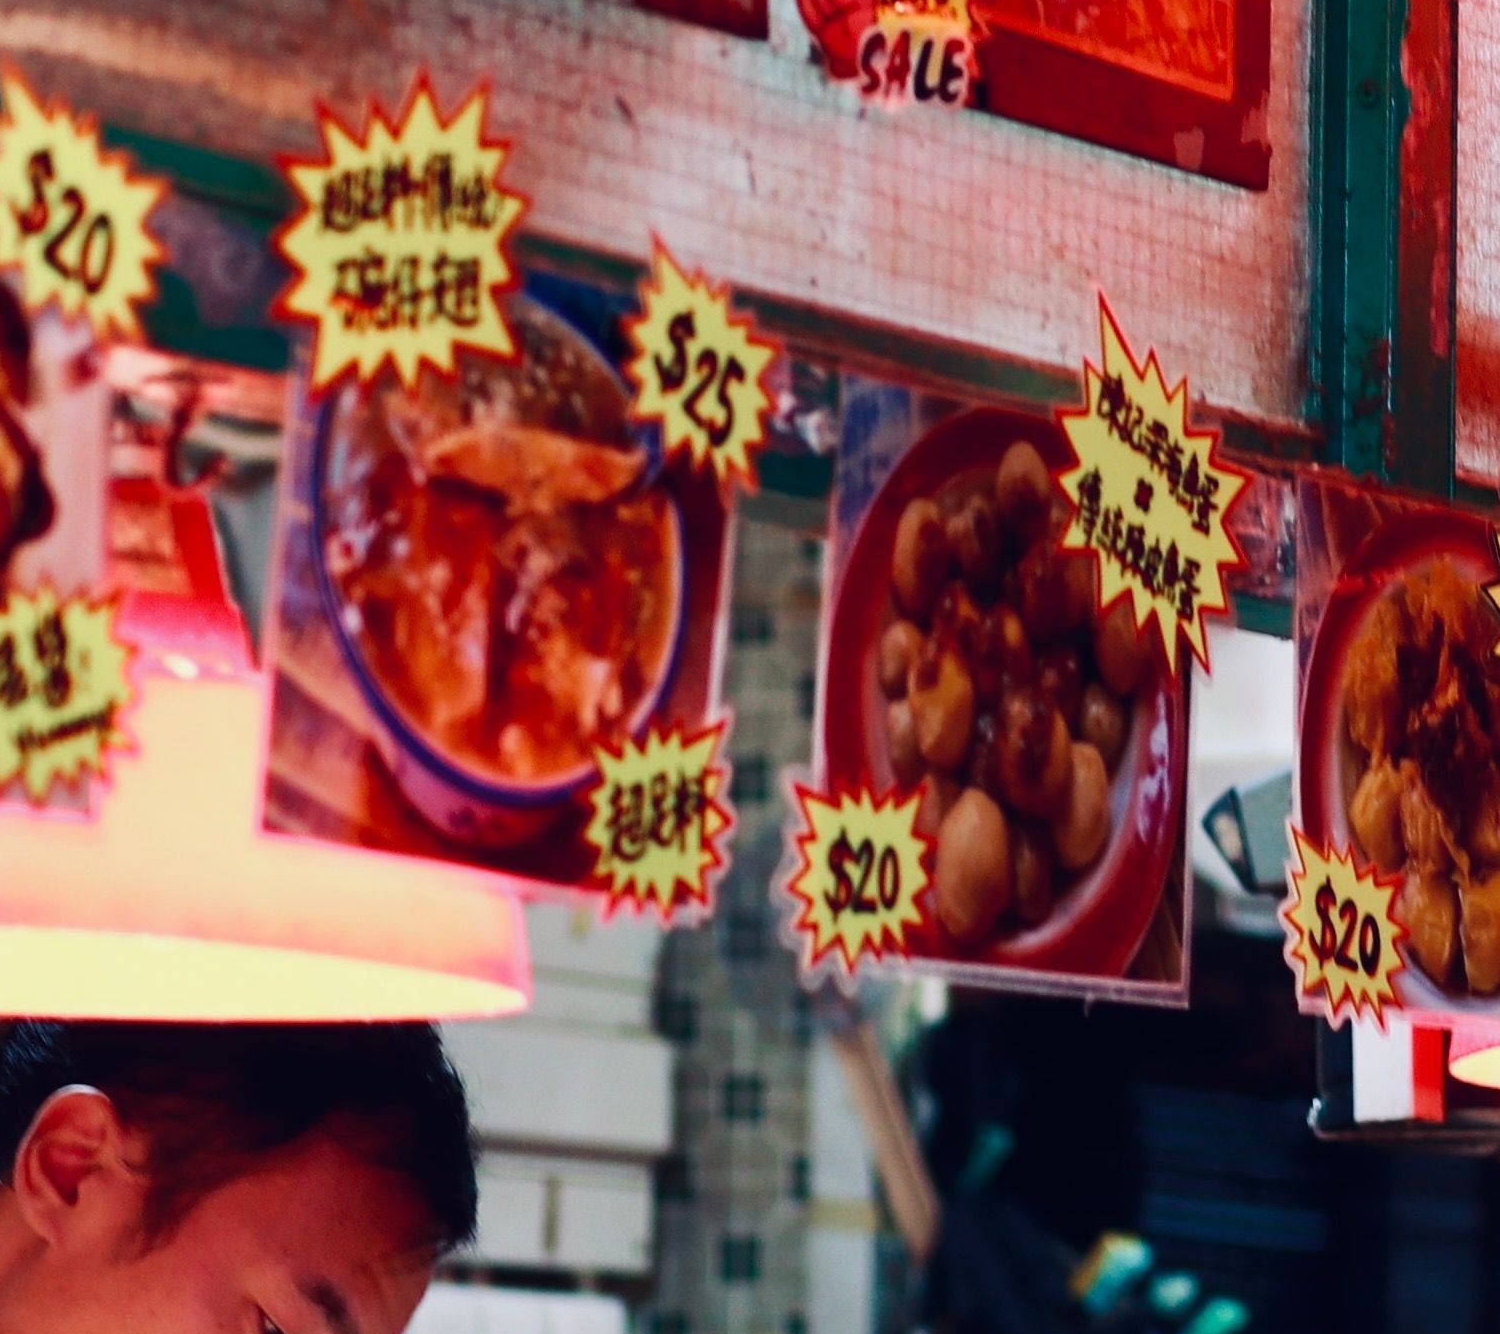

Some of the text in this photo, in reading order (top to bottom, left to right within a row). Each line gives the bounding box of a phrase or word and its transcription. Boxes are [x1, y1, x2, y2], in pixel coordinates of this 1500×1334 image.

[861, 30, 966, 103] SALE
[15, 148, 116, 296] $20
[653, 311, 744, 448] $25
[825, 820, 900, 923] $20
[1307, 876, 1382, 977] $20
